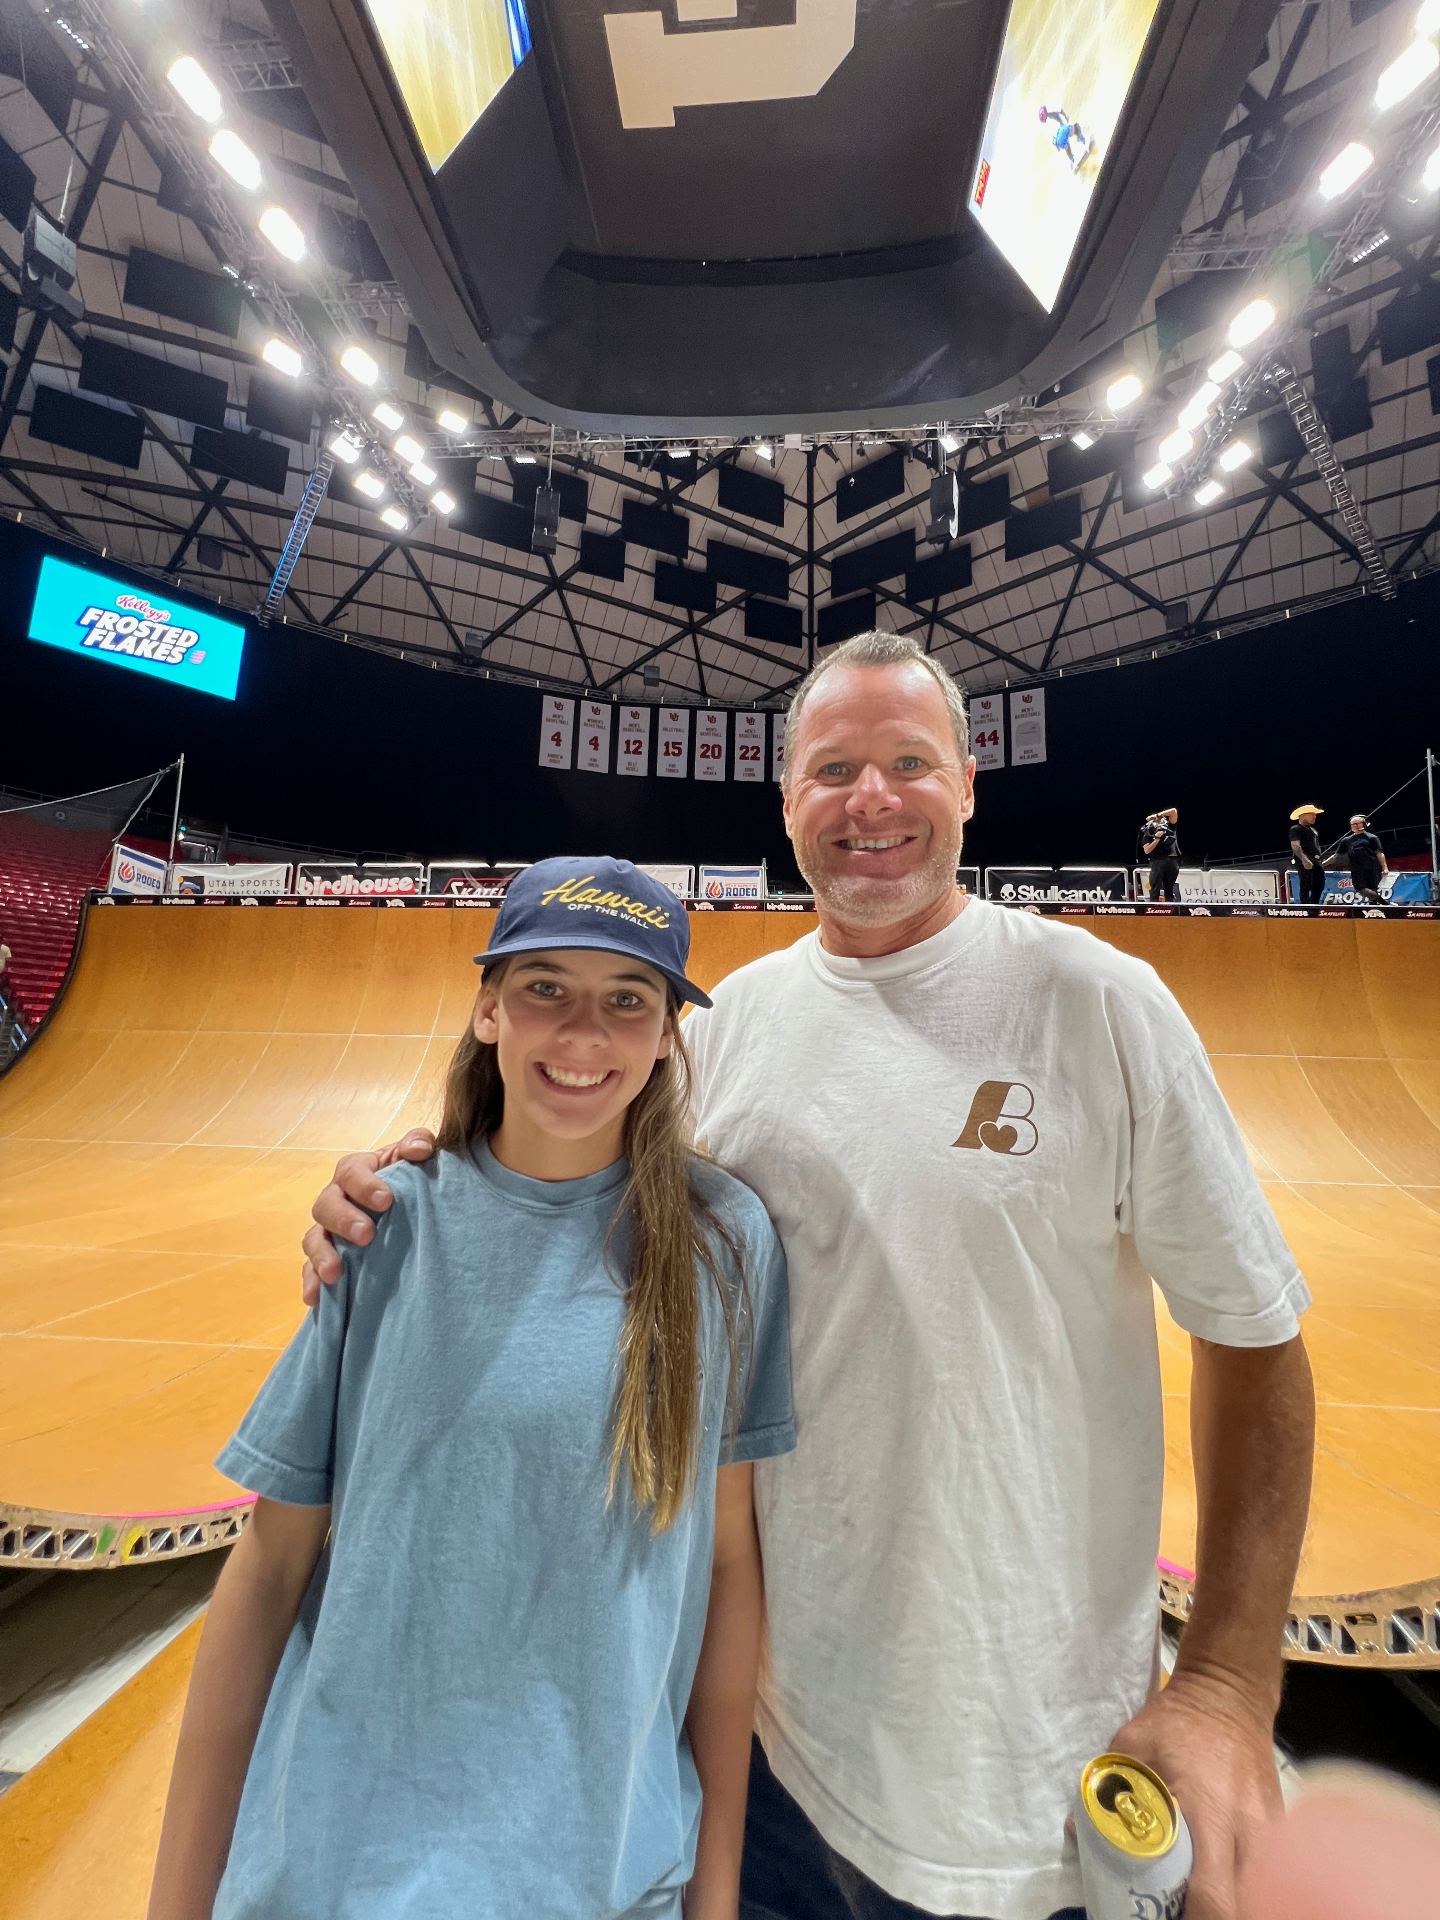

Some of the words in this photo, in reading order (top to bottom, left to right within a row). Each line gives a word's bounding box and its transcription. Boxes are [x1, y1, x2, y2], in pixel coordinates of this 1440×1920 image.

[117, 595, 171, 620] Kellogg's
[79, 607, 198, 648] FROSTED
[83, 628, 187, 664] FLAKES
[551, 731, 562, 747] 4
[589, 735, 599, 751] 4
[975, 730, 999, 747] 44
[624, 739, 643, 755] 12
[663, 741, 683, 757] 15
[700, 743, 722, 759] 20
[739, 745, 760, 761] 22
[136, 872, 161, 889] RODEO
[208, 879, 235, 888] UTAH
[240, 879, 281, 887] SPORTS
[299, 874, 413, 895] birdhouse
[726, 888, 758, 896] RODEO
[1018, 884, 1112, 901] Skullcandy
[1185, 888, 1217, 897] UTAH
[1223, 889, 1270, 897] SPORTS
[541, 875, 670, 929] Hawaii
[567, 903, 592, 911] OFF
[595, 905, 618, 917] THE
[620, 912, 649, 929] WALL
[1268, 908, 1309, 916] birdhouse
